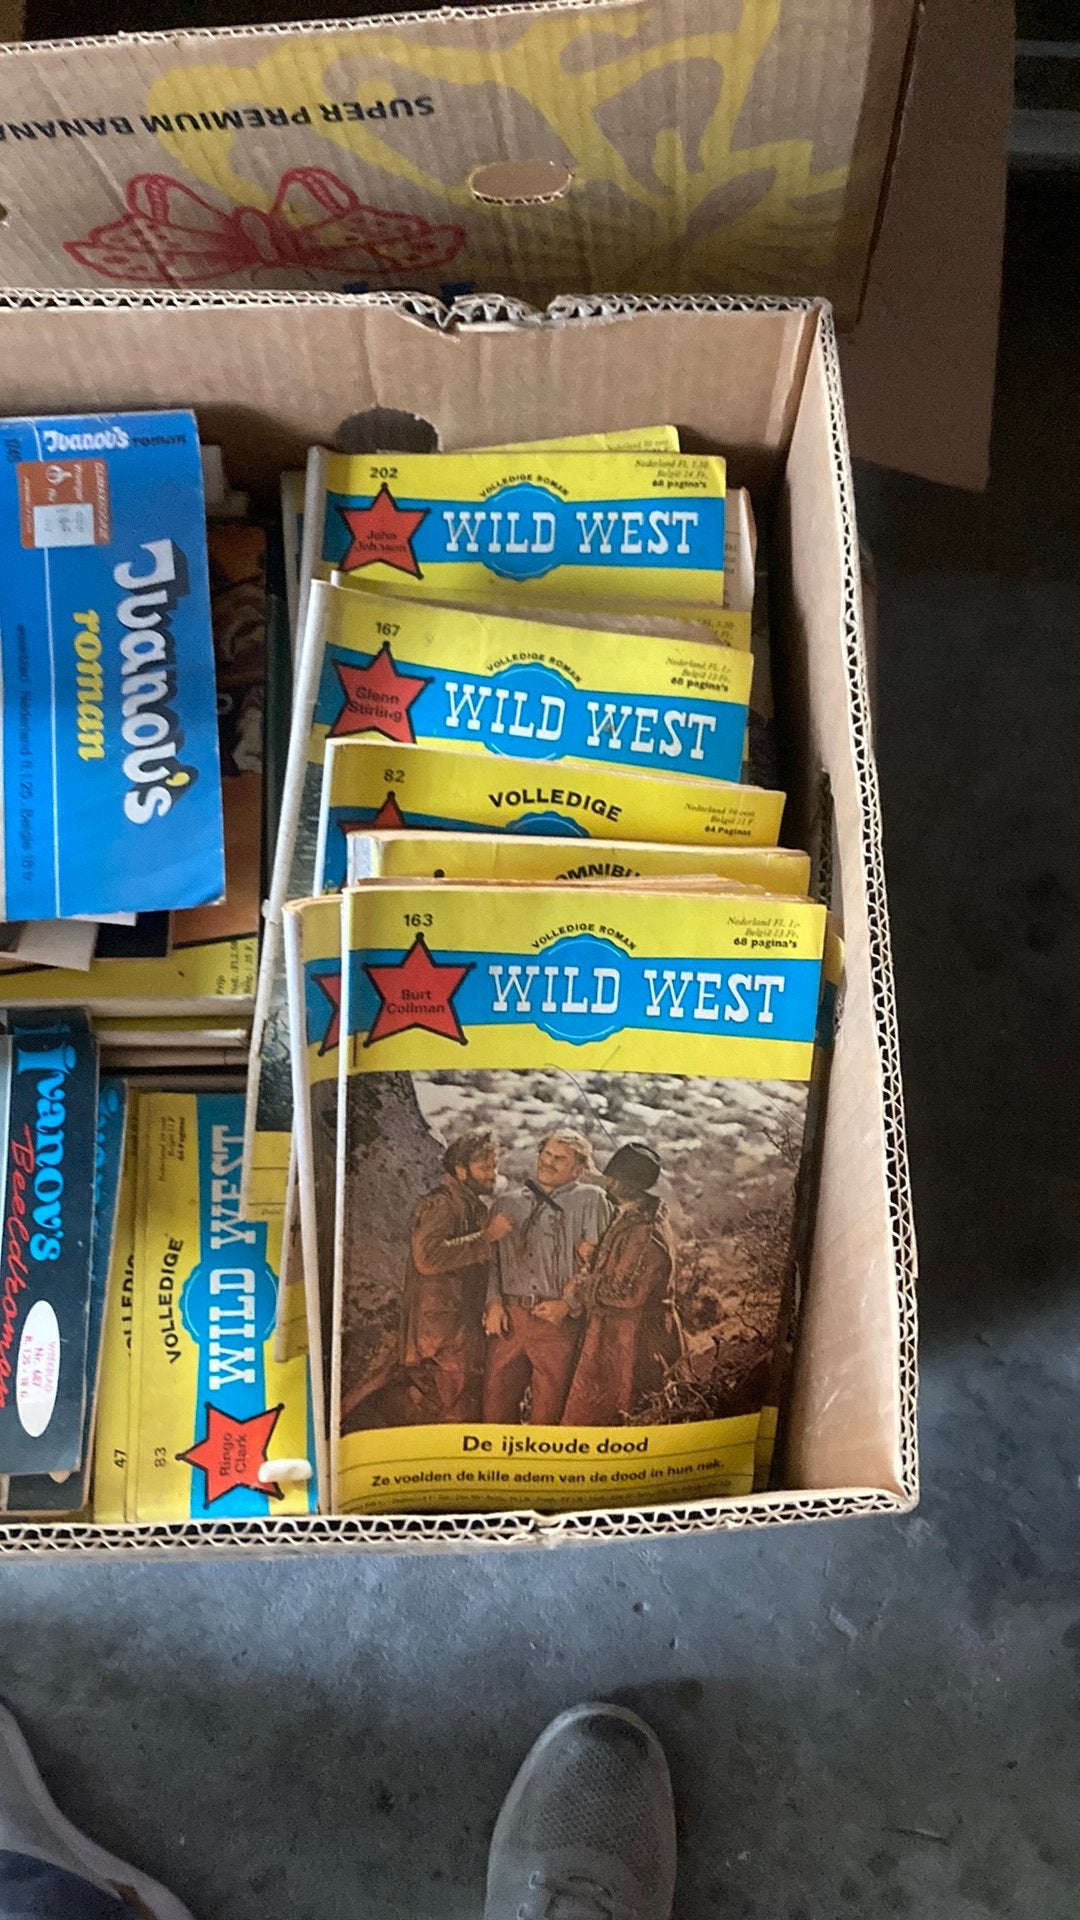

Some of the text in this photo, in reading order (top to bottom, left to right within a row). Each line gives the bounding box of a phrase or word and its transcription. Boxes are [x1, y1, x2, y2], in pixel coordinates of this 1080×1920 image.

[139, 106, 313, 134] PREMIUM
[319, 96, 435, 123] SUPER
[370, 467, 399, 479] 202
[480, 474, 570, 498] VOLLEDIGE ROMAN
[443, 510, 699, 555] WILD WEST
[376, 621, 401, 637] 167
[486, 652, 582, 683] VOLLEDIGE ROMAN
[72, 609, 106, 762] roman
[356, 686, 400, 705] Glenn
[687, 680, 729, 693] pagina's
[347, 700, 402, 723] Stirling
[445, 682, 718, 762] WILD WEST
[384, 768, 405, 783] 82
[488, 788, 622, 823] VOLLEDIGE
[403, 913, 433, 927] 163
[532, 923, 637, 951] VOLLEDIGE ROMAN
[733, 937, 798, 950] 68 pagina's
[401, 989, 432, 1001] Burt
[488, 965, 785, 1024] WILD WEST
[17, 1045, 77, 1262] Ivanov's
[209, 1124, 257, 1391] WILD WEST
[158, 1237, 184, 1365] VOLLEDIGE
[114, 1448, 126, 1469] 47
[153, 1446, 167, 1468] 83
[219, 1432, 235, 1476] Ringo
[235, 1434, 248, 1474] Clark
[462, 1435, 649, 1457] De ijskoude dood
[371, 1475, 390, 1487] Ze
[394, 1471, 452, 1485] voelden
[456, 1471, 474, 1482] de
[477, 1470, 509, 1482] kille
[513, 1471, 554, 1484] adem
[558, 1473, 586, 1484] van
[589, 1472, 608, 1483] de
[611, 1469, 647, 1484] dood
[651, 1468, 664, 1479] in
[667, 1464, 693, 1476] hun
